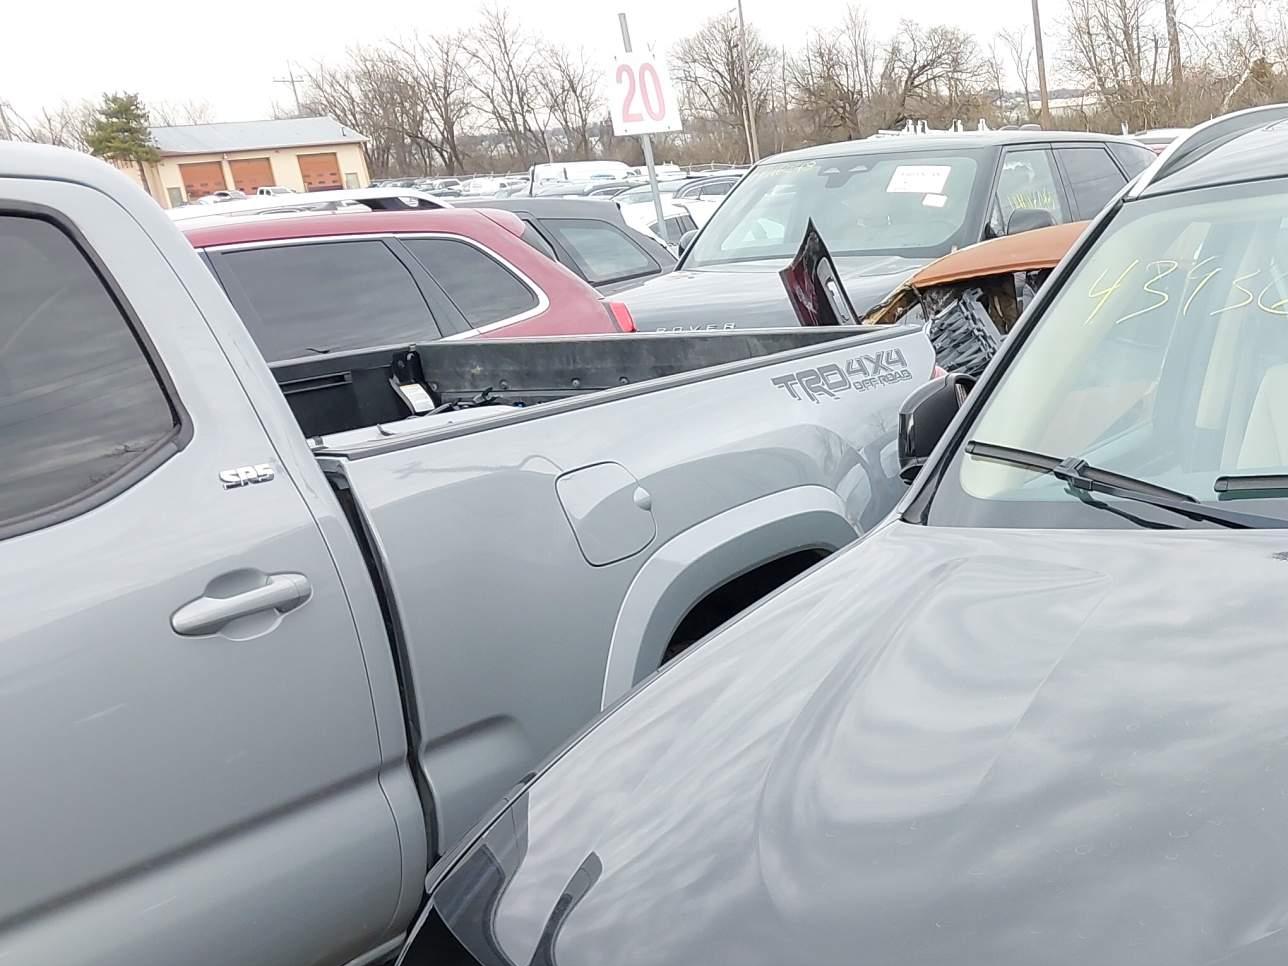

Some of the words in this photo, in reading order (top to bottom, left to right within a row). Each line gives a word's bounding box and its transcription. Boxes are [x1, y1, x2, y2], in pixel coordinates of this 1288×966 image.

[615, 63, 666, 123] 20
[770, 363, 852, 404] TRD
[853, 377, 880, 392] OFF
[879, 369, 913, 387] ROAD
[219, 463, 275, 490] SR5
